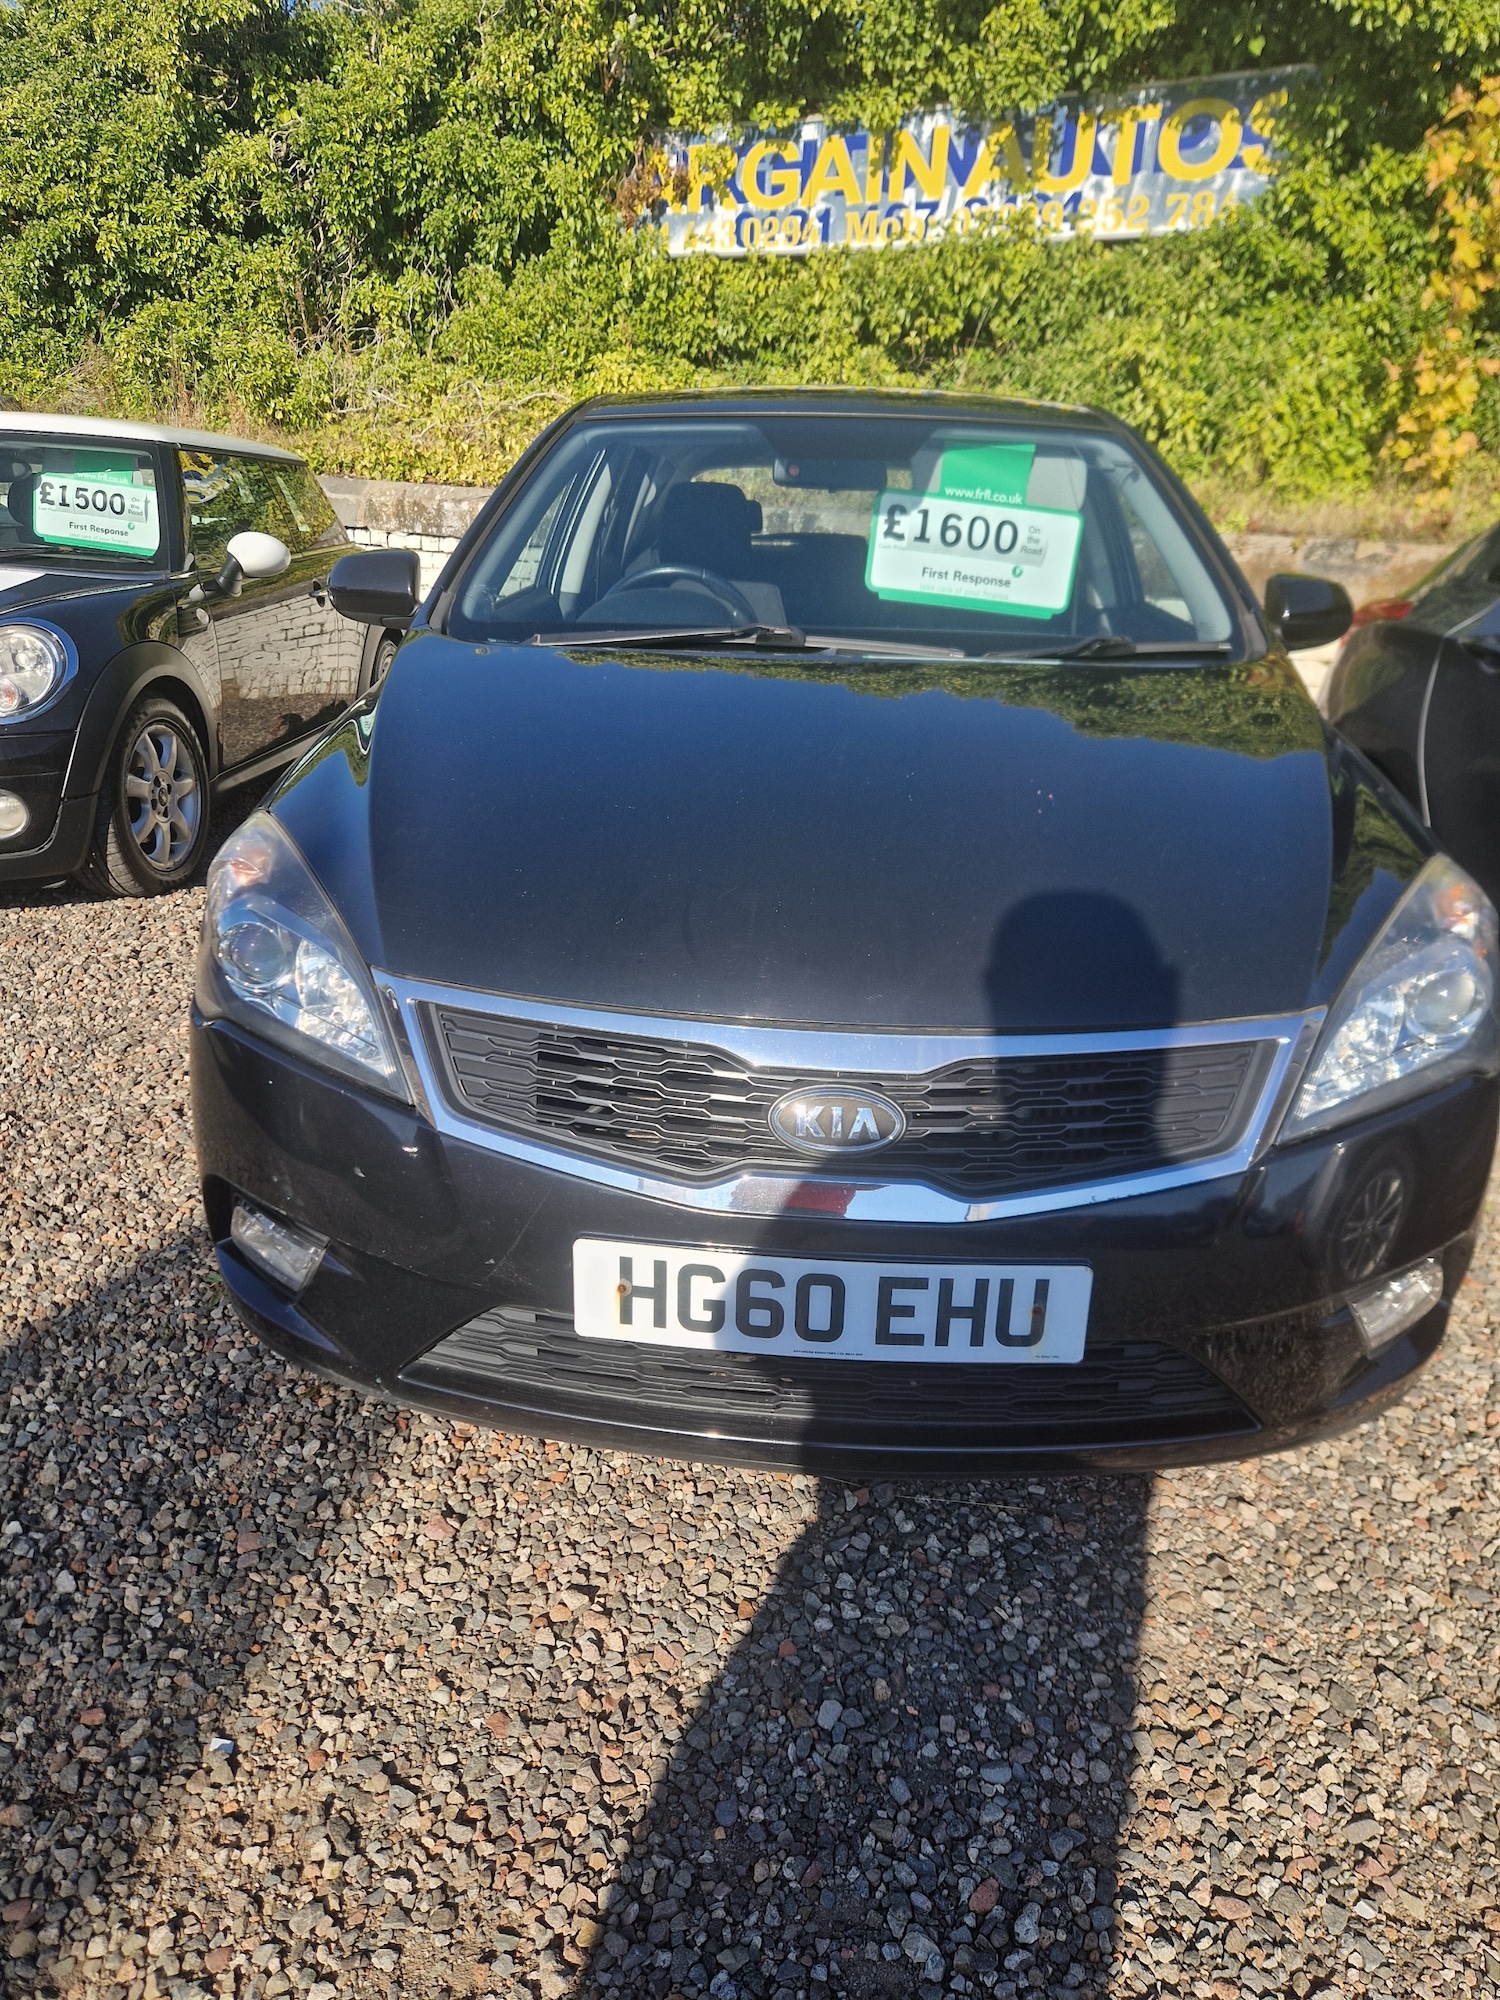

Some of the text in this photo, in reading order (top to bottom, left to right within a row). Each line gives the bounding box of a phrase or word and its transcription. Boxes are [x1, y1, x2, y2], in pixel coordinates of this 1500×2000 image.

[962, 87, 1289, 198] AUTOS
[1077, 194, 1150, 234] 252
[39, 481, 126, 516] £1500
[944, 485, 1024, 506] www.frfl.co.uk
[128, 509, 144, 517] Road
[69, 521, 129, 537] First Response
[882, 503, 1019, 555] £1600
[1028, 525, 1041, 534] On
[1019, 545, 1044, 557] Road
[1026, 535, 1041, 546] the
[921, 566, 1012, 588] First Response
[795, 1104, 880, 1140] KIA
[618, 1255, 1051, 1348] HG60 EHU
